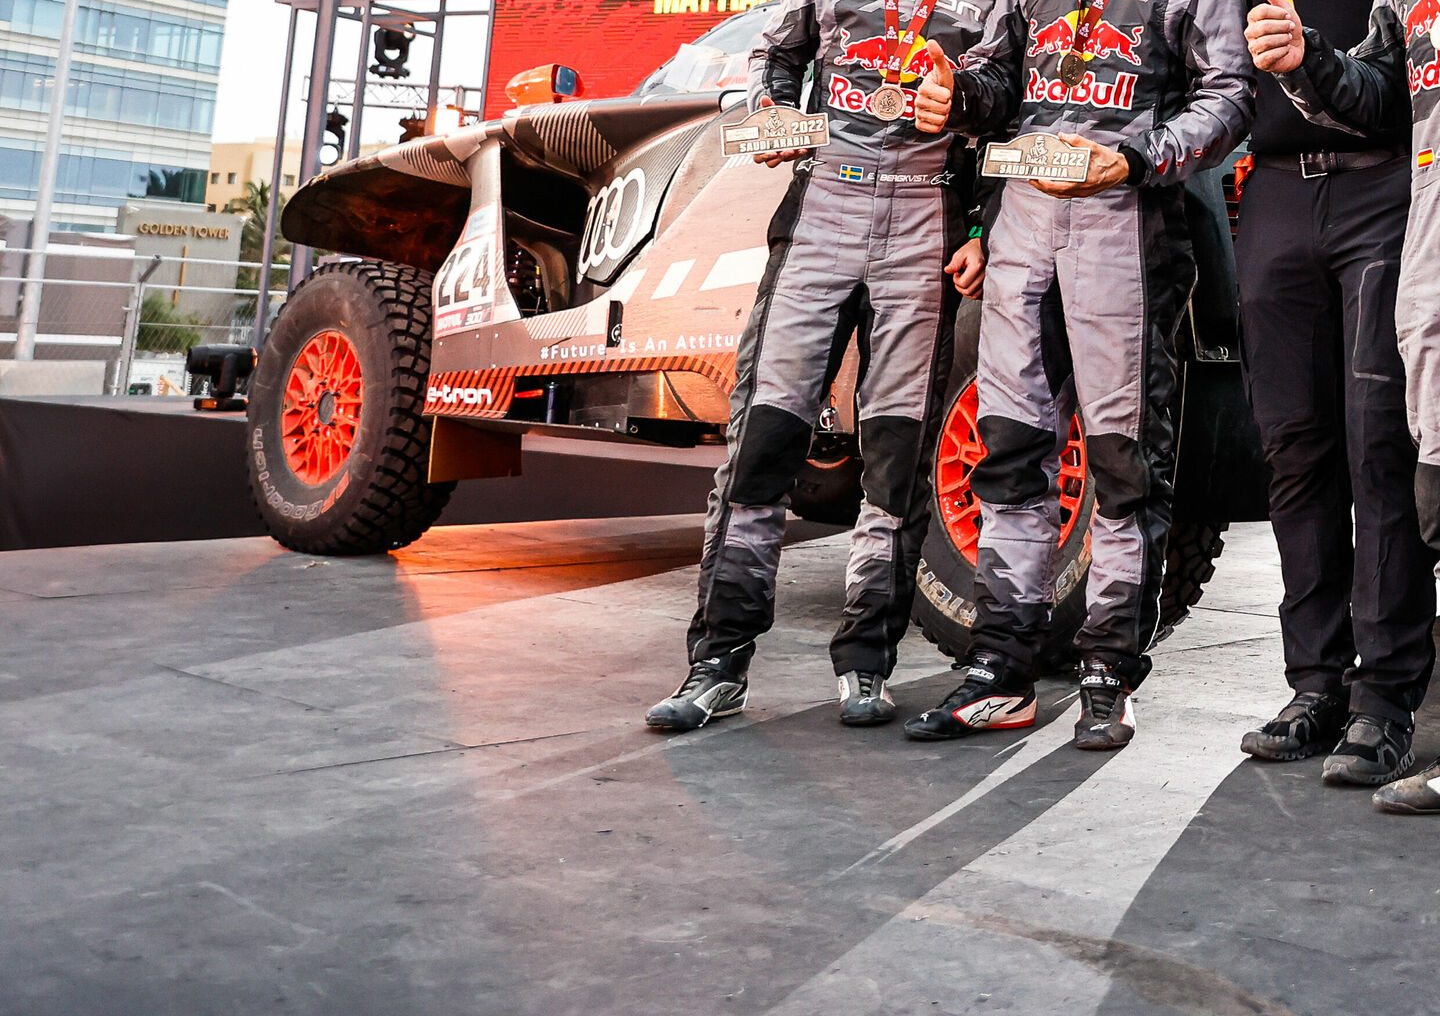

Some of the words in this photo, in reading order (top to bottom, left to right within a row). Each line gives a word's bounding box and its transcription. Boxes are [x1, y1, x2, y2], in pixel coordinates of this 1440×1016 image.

[1068, 70, 1139, 111] Bull
[791, 118, 825, 136] 2022
[739, 140, 771, 154] SAUDI
[772, 135, 811, 150] ARABIA
[1053, 151, 1086, 167] 2022
[999, 164, 1030, 175] SAUDI
[1031, 166, 1069, 178] ARABIA
[138, 222, 187, 236] GOLDEN
[191, 225, 231, 240] TOWER
[438, 242, 491, 308] 224
[540, 342, 606, 360] #Future
[619, 338, 636, 354] Is
[643, 335, 667, 353] An
[675, 332, 743, 350] Attitu
[427, 383, 493, 405] e-tron
